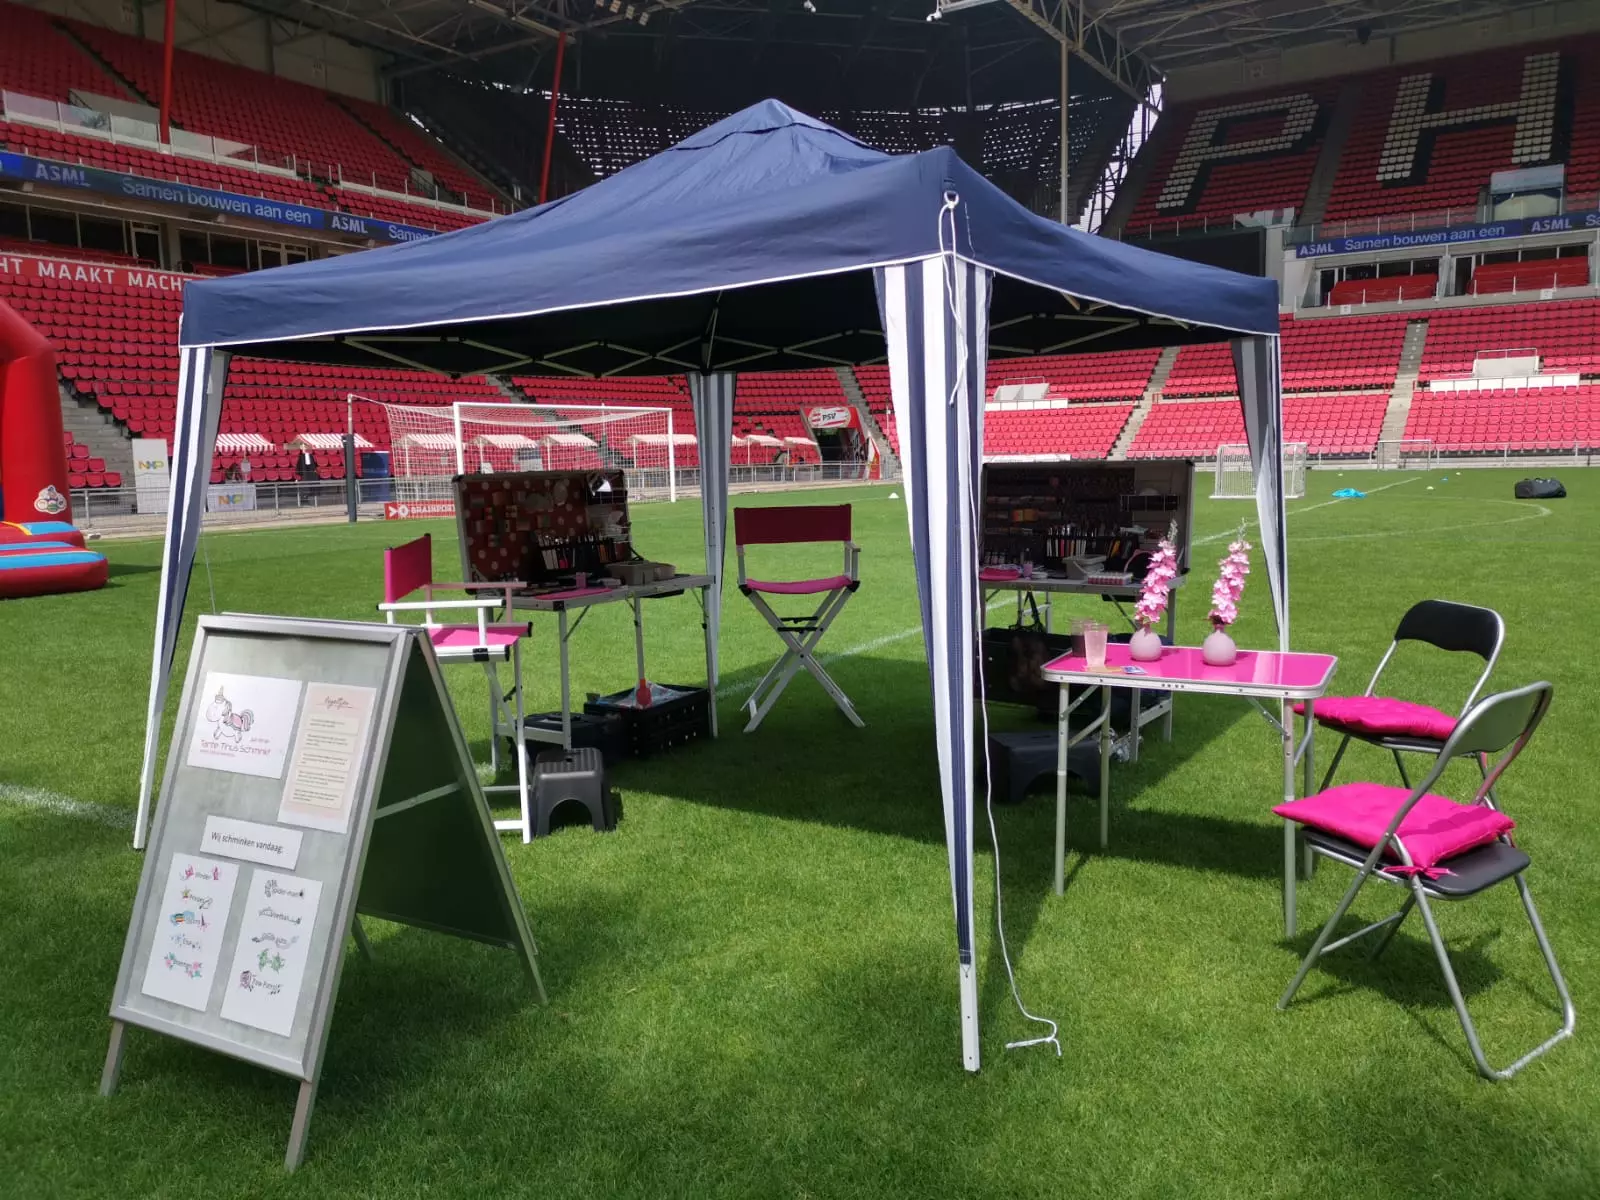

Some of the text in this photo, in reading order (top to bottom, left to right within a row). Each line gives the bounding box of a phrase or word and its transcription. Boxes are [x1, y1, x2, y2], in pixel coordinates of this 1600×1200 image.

[35, 161, 91, 188] ASML
[121, 177, 184, 203] Samen
[187, 188, 251, 214] bouwen
[255, 203, 283, 220] aan
[285, 208, 312, 225] een
[331, 215, 369, 235] ASML
[1300, 242, 1335, 256] ASML
[1344, 237, 1390, 252] Samen
[1392, 232, 1448, 247] bouwen
[1450, 229, 1476, 241] aan
[1479, 226, 1506, 238] een
[1531, 218, 1573, 233] ASML
[37, 261, 116, 285] MAAKT
[822, 412, 837, 421] PSV
[138, 460, 165, 470] NXP
[218, 493, 245, 505] NXP
[211, 831, 222, 843] Wij
[222, 833, 255, 848] schminken
